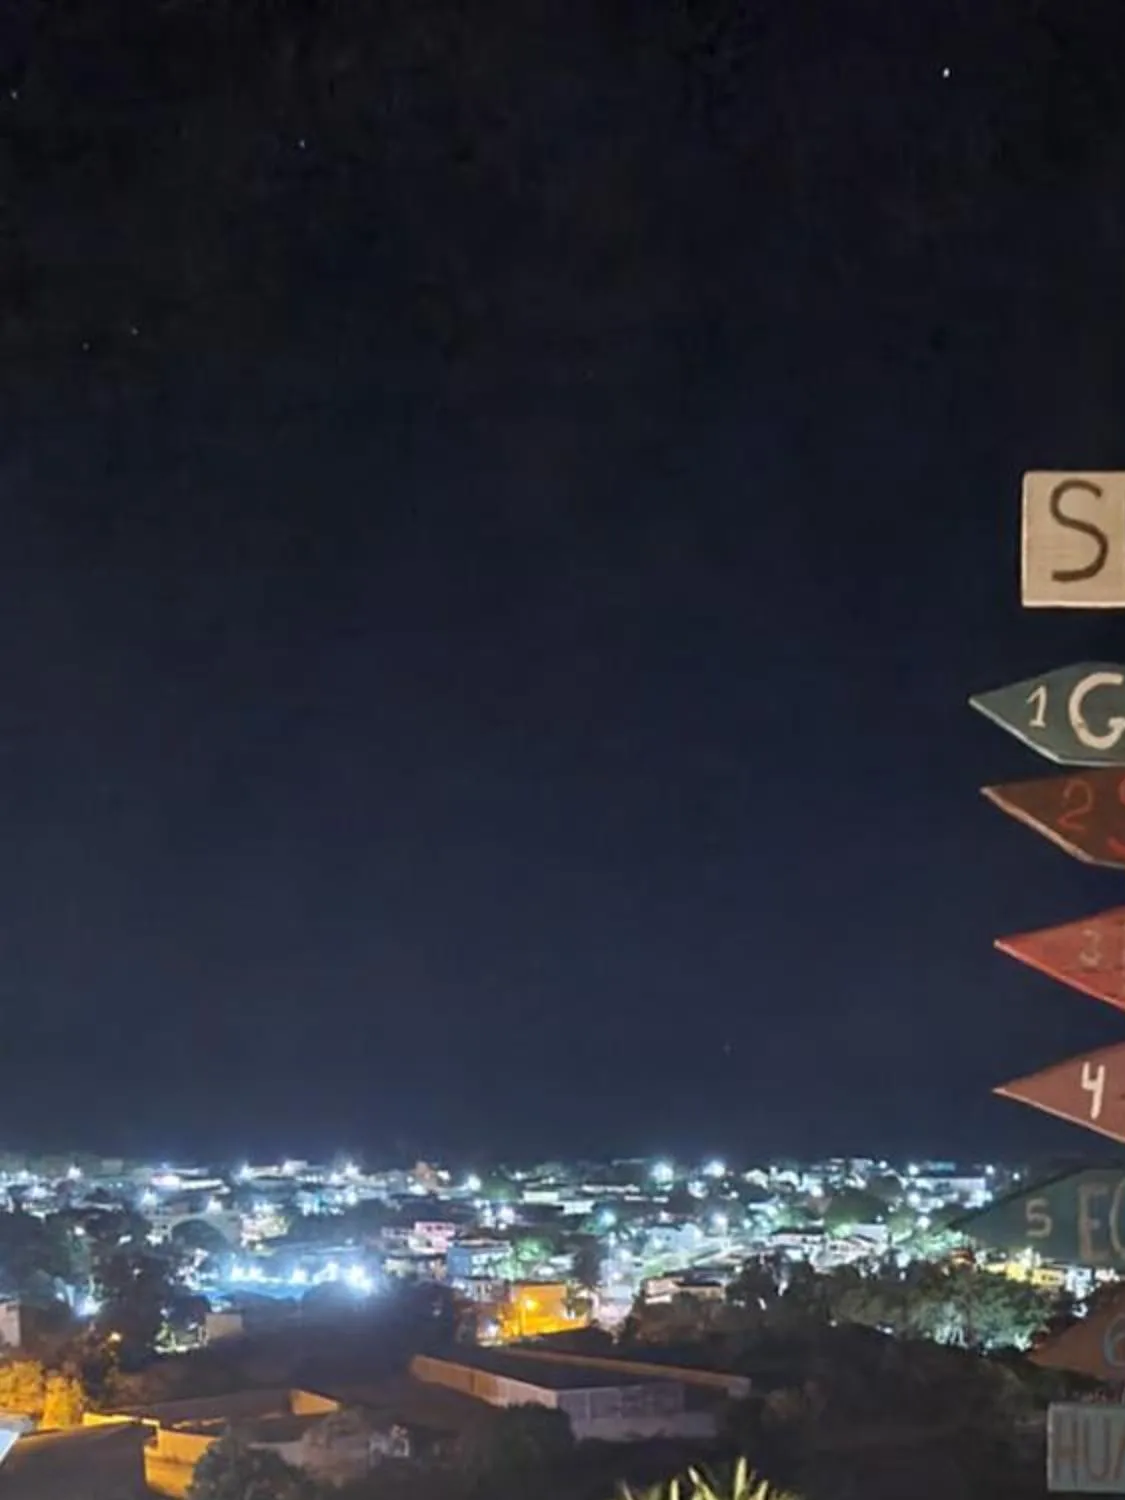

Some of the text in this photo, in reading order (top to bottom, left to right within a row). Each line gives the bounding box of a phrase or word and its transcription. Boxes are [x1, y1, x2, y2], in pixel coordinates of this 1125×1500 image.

[1026, 685, 1047, 728] 1
[1056, 779, 1095, 832] 2
[1079, 929, 1103, 967] 3
[1081, 1061, 1106, 1119] 4
[1025, 1198, 1053, 1238] 5
